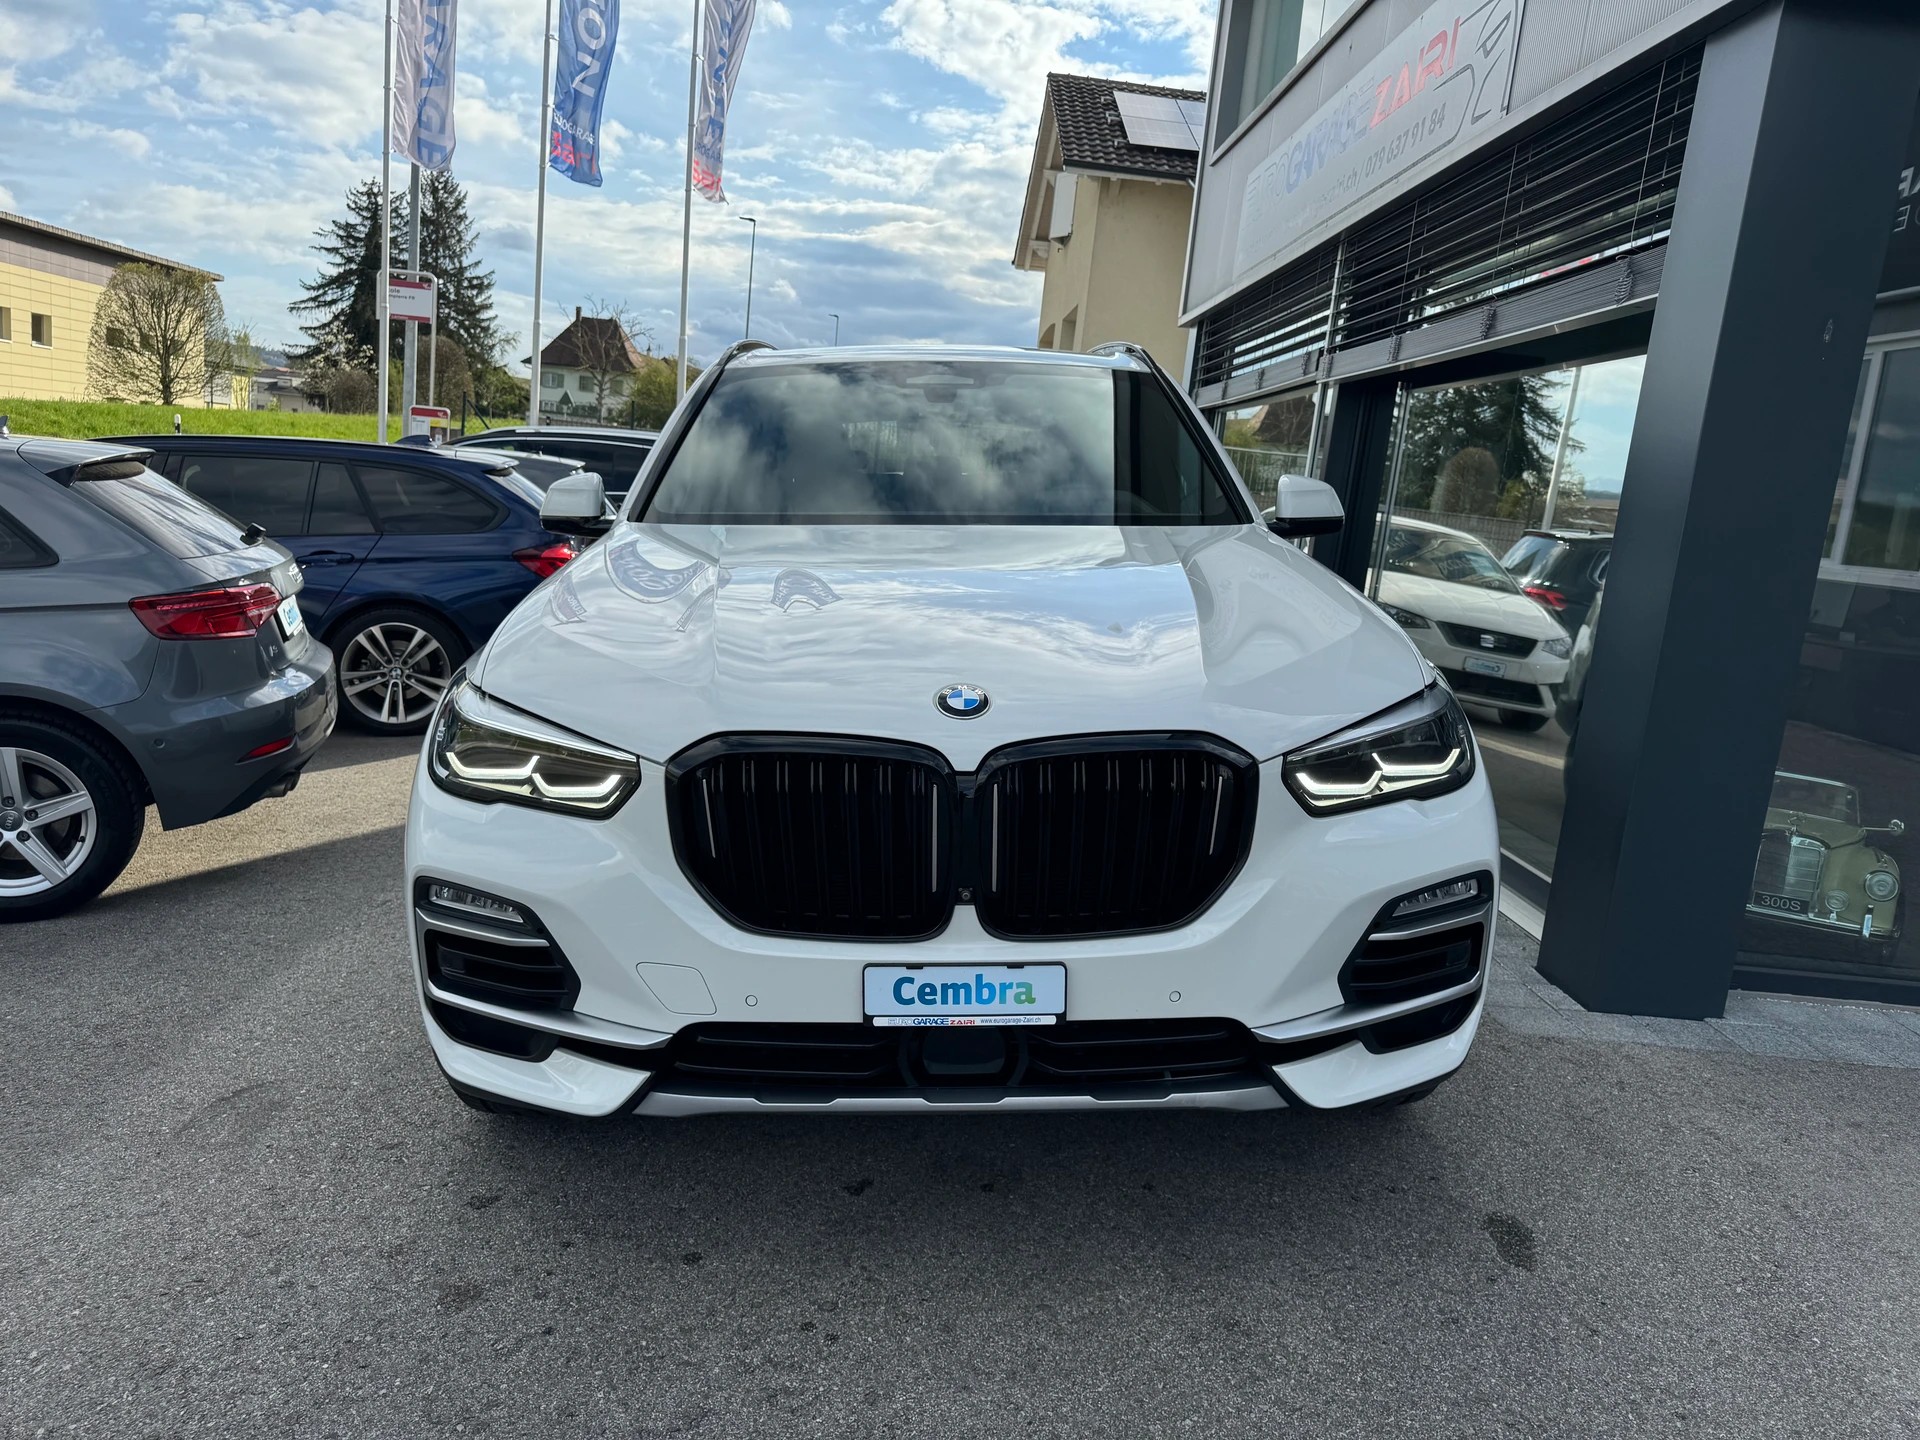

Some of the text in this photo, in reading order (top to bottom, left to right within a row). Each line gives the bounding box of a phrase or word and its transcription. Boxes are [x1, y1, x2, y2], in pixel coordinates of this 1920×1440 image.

[1369, 16, 1461, 130] ZAIRI
[1365, 146, 1386, 179] 079
[1386, 130, 1408, 165] 637
[1411, 117, 1426, 149] 91
[1429, 102, 1447, 136] 84
[943, 685, 984, 695] BMW
[1761, 895, 1801, 911] 300S
[892, 973, 1037, 1006] Cembra
